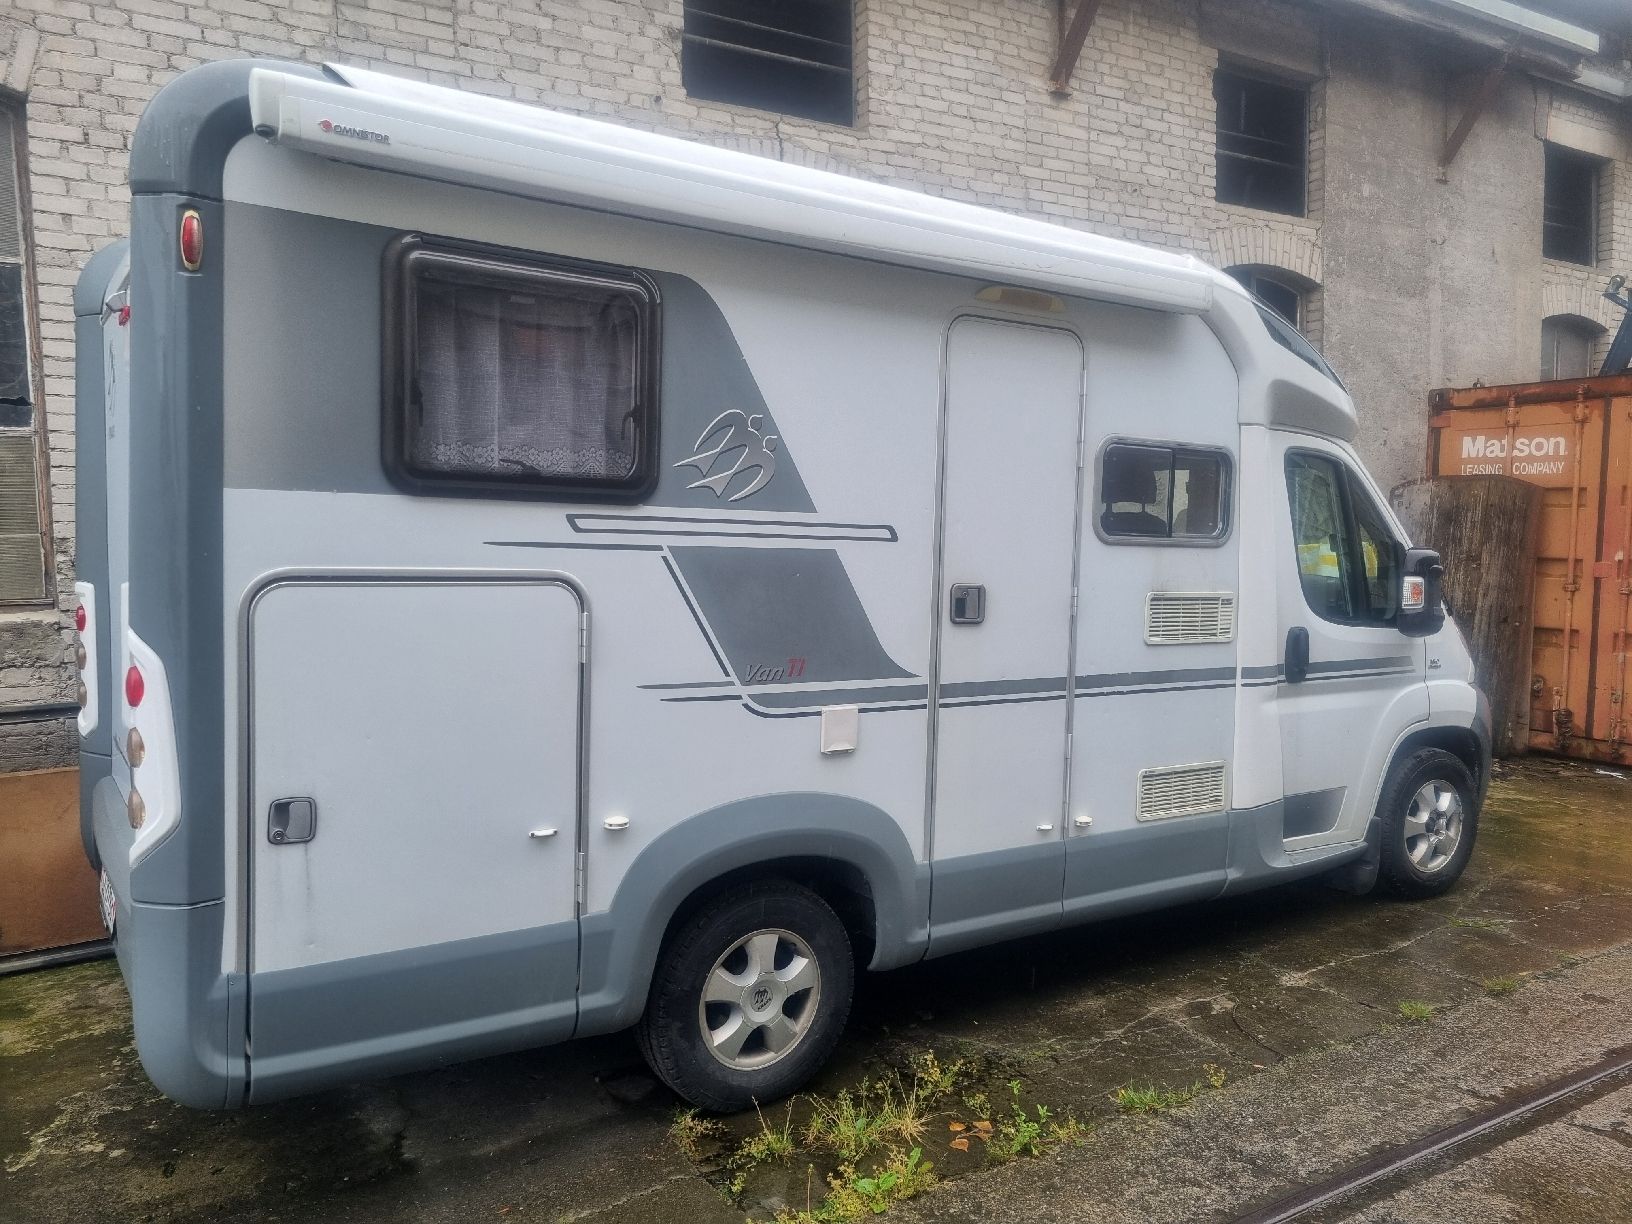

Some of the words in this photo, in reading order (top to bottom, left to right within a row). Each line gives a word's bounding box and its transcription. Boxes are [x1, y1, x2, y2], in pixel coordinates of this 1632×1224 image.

[333, 124, 391, 145] OMNISTOR
[1461, 463, 1503, 476] LEASING
[1512, 461, 1565, 475] COMPANY
[745, 663, 785, 682] Van
